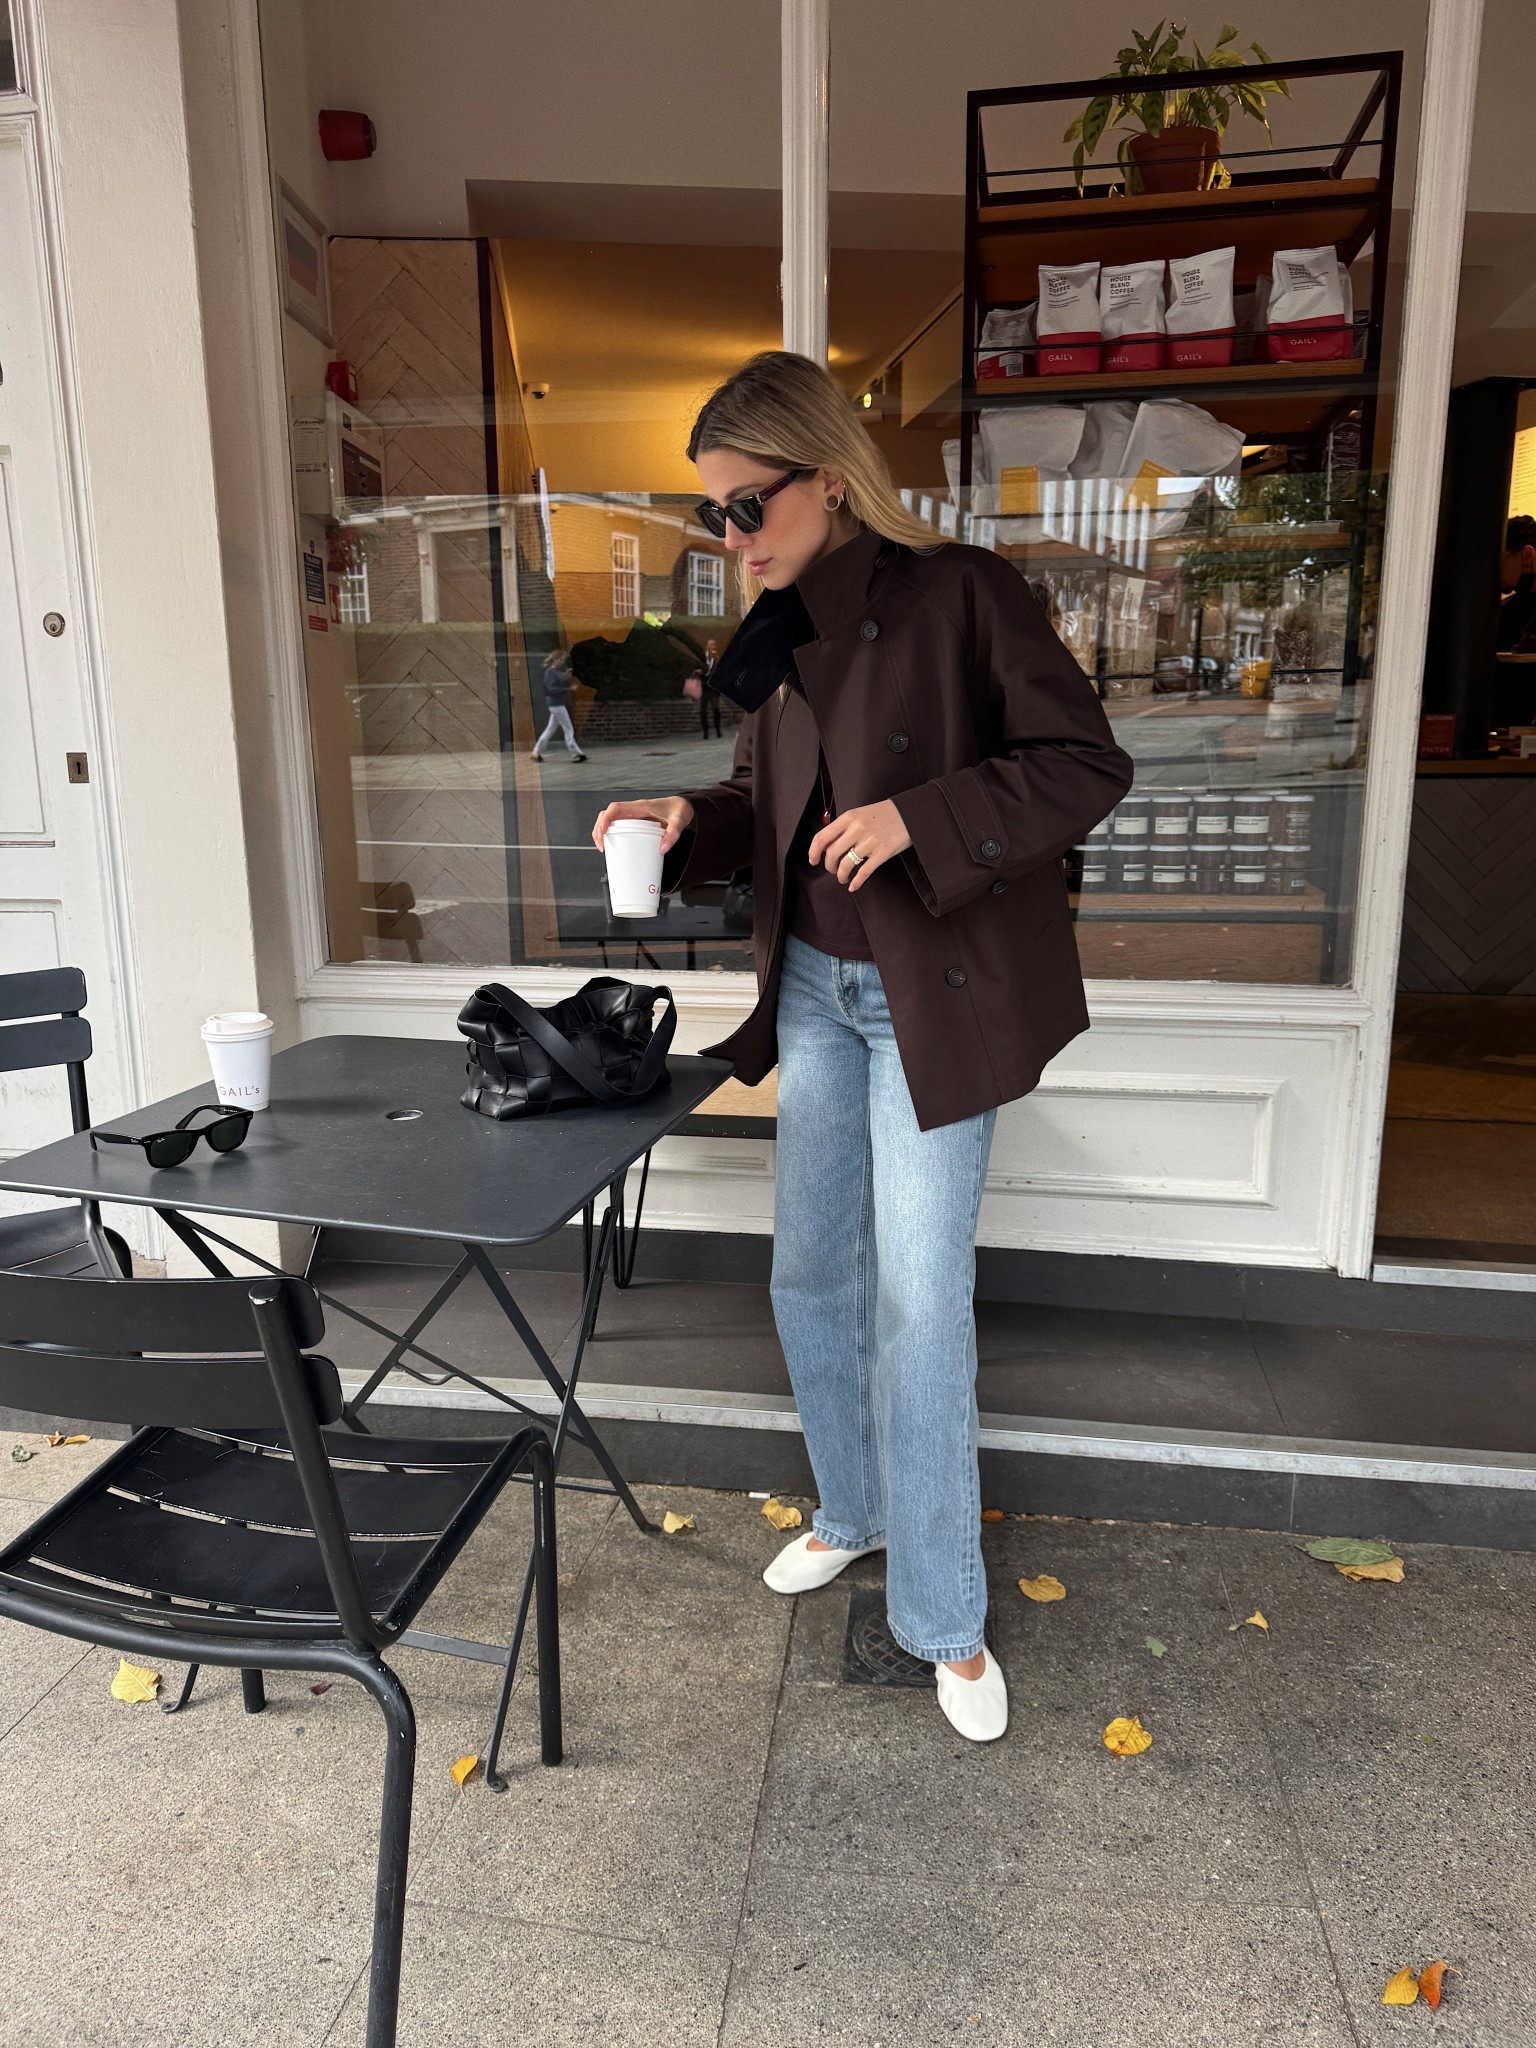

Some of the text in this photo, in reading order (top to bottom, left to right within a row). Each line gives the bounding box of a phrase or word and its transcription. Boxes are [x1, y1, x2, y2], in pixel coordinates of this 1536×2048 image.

[1182, 268, 1201, 277] HOUSE
[1110, 275, 1131, 283] HOUSE
[1183, 275, 1200, 283] BLEND
[1184, 280, 1204, 290] COFFEE
[1048, 285, 1071, 294] COFFEE
[1110, 287, 1134, 295] COFFEE
[1048, 354, 1073, 362] GAIL's
[220, 1085, 260, 1096] GAIL's
